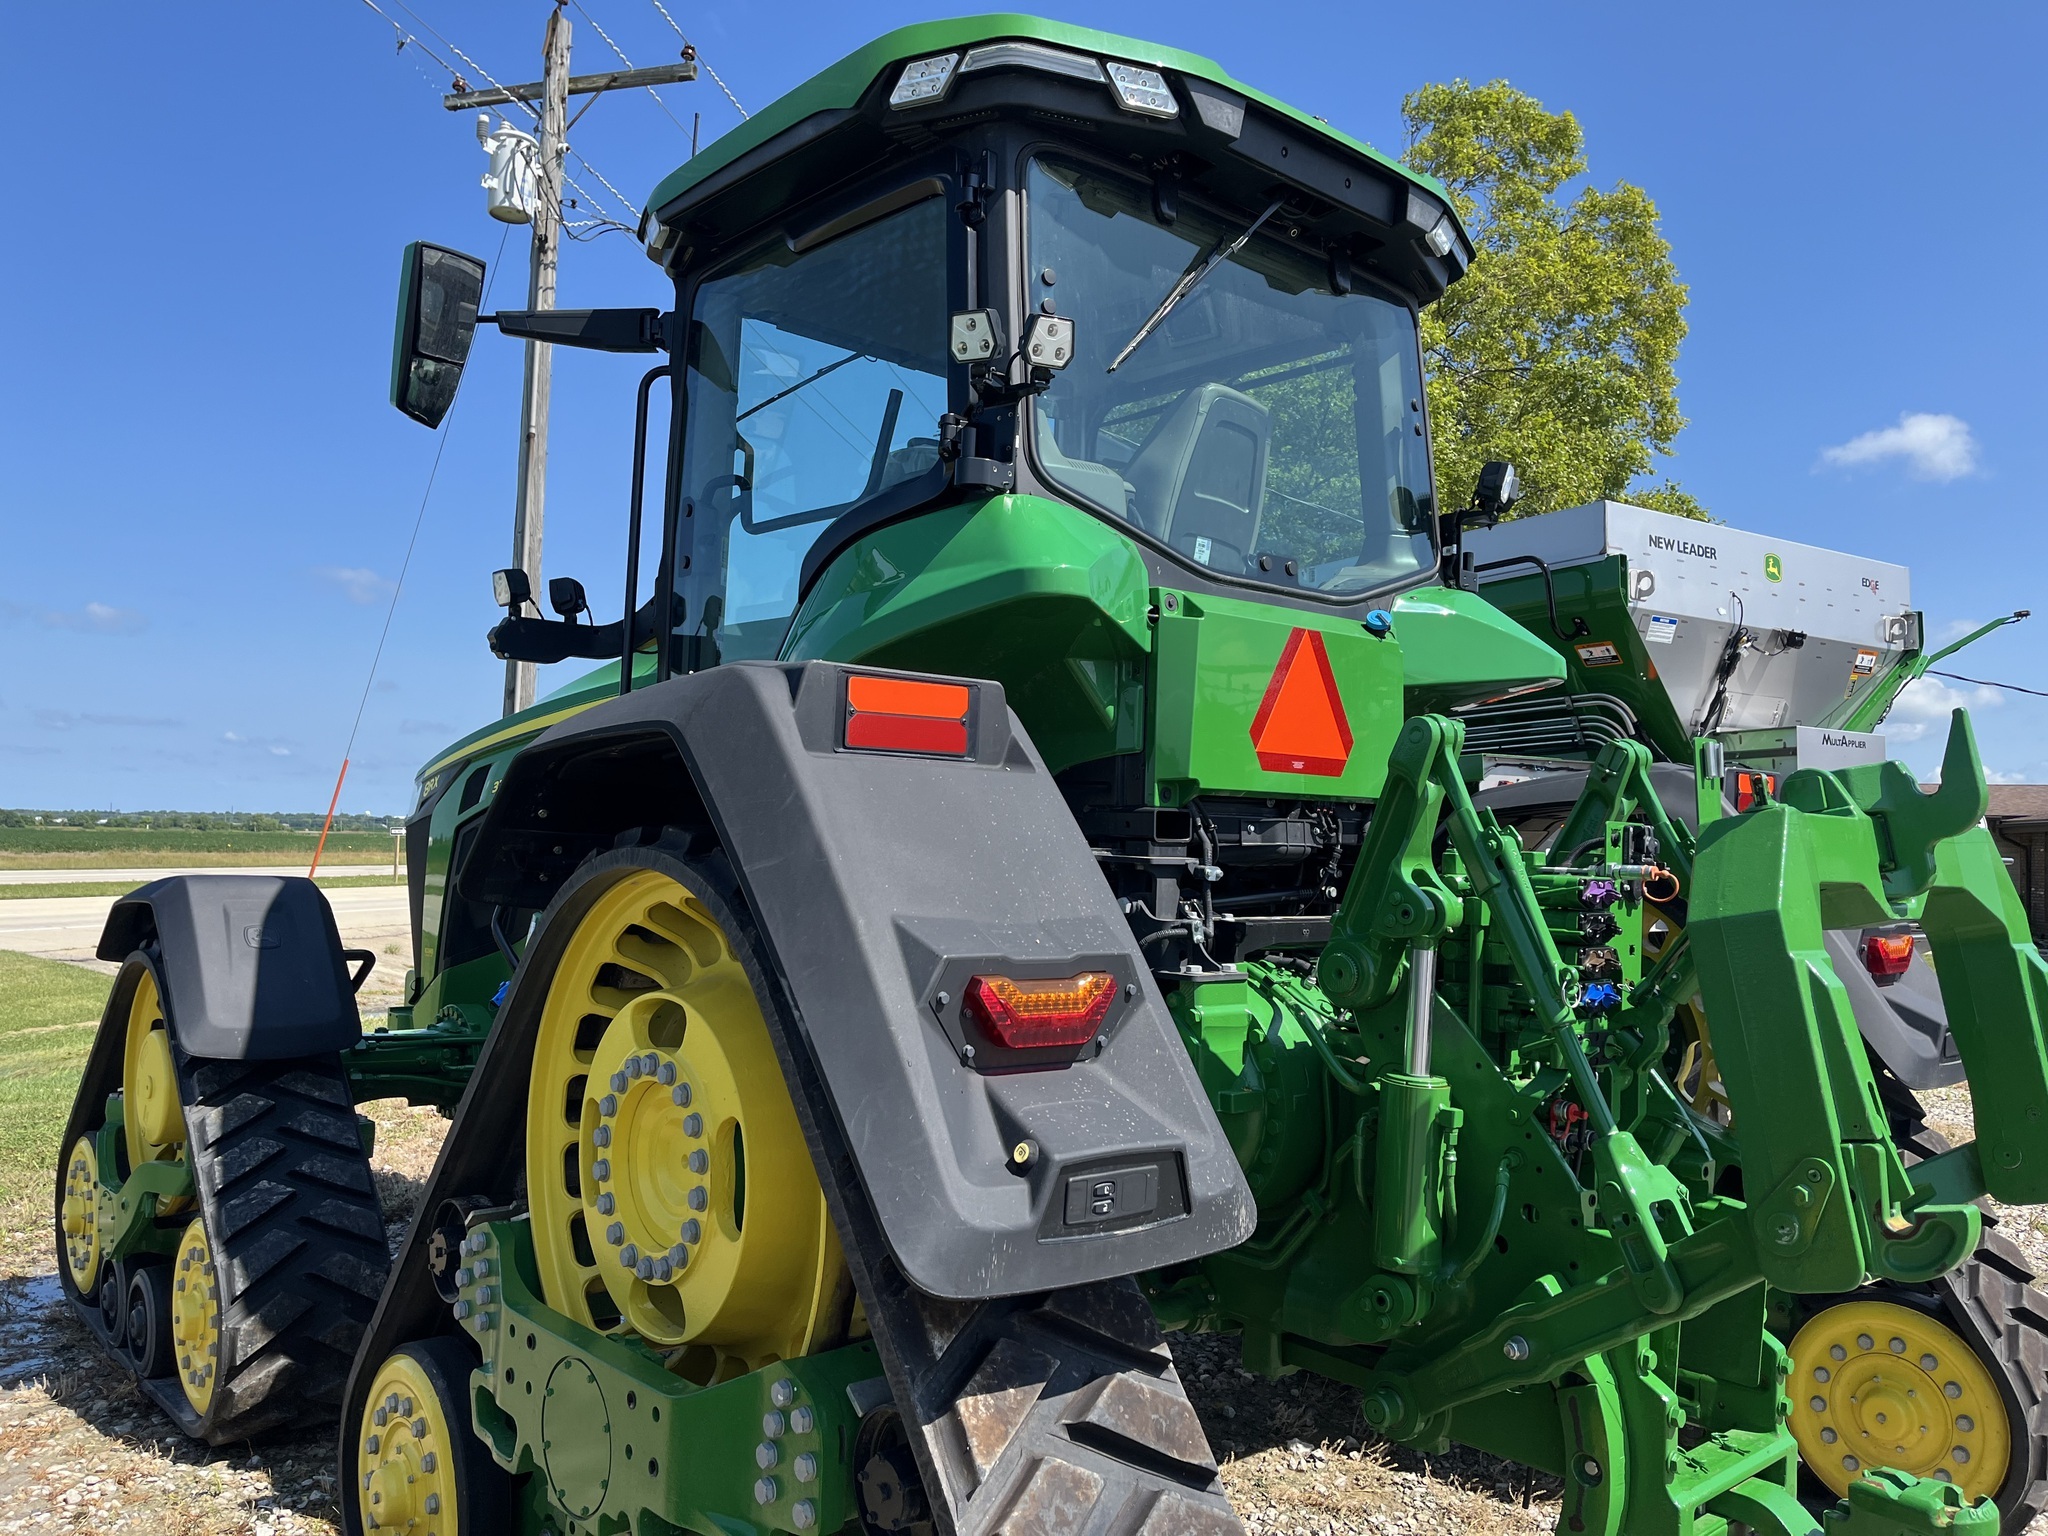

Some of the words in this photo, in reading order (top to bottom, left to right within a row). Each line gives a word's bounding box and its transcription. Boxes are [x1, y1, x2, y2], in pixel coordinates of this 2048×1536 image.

[1649, 534, 1675, 551] NEW
[1677, 540, 1717, 560] LEADER
[1862, 577, 1879, 592] EDGE
[423, 775, 439, 797] 8RX
